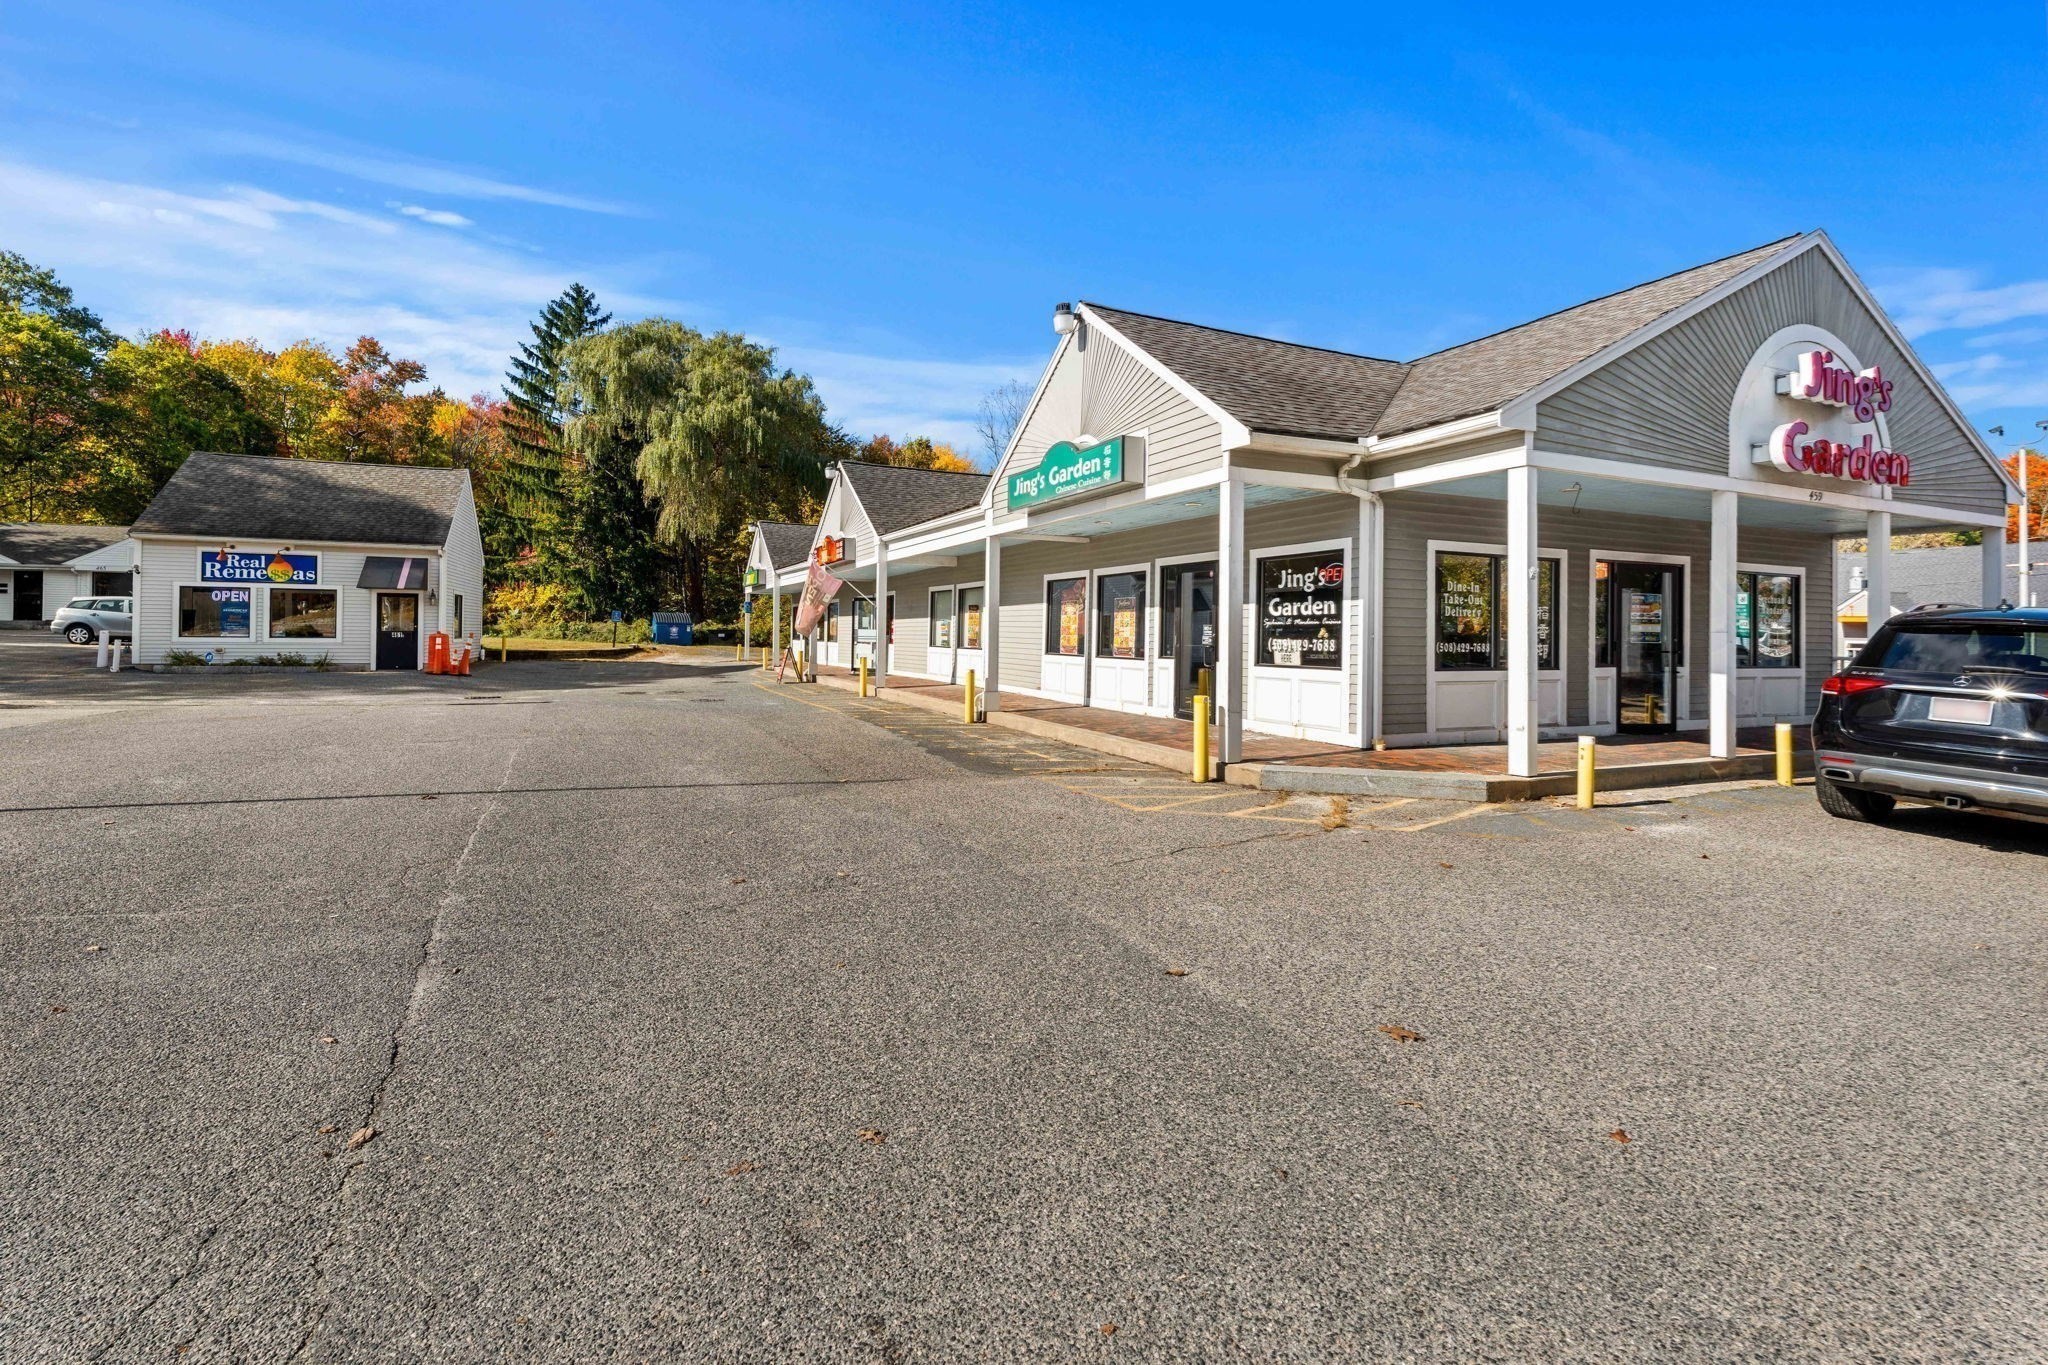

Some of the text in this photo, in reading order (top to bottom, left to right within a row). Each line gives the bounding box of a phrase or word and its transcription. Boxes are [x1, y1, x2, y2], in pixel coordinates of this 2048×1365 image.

[1801, 351, 1893, 423] Jing's
[1780, 421, 1910, 487] Garden
[1014, 457, 1101, 496] Jing's Garden
[1809, 490, 1823, 501] 459
[227, 553, 266, 568] Real
[1278, 567, 1326, 593] Jing's
[1447, 580, 1480, 592] Dine-In
[211, 590, 249, 602] OPEN
[1443, 593, 1484, 605] Take-Out
[1268, 596, 1336, 617] Garden
[1445, 605, 1482, 619] Delivery
[1268, 637, 1336, 653] (508)429-7688
[1436, 641, 1490, 654] (508)429-7688
